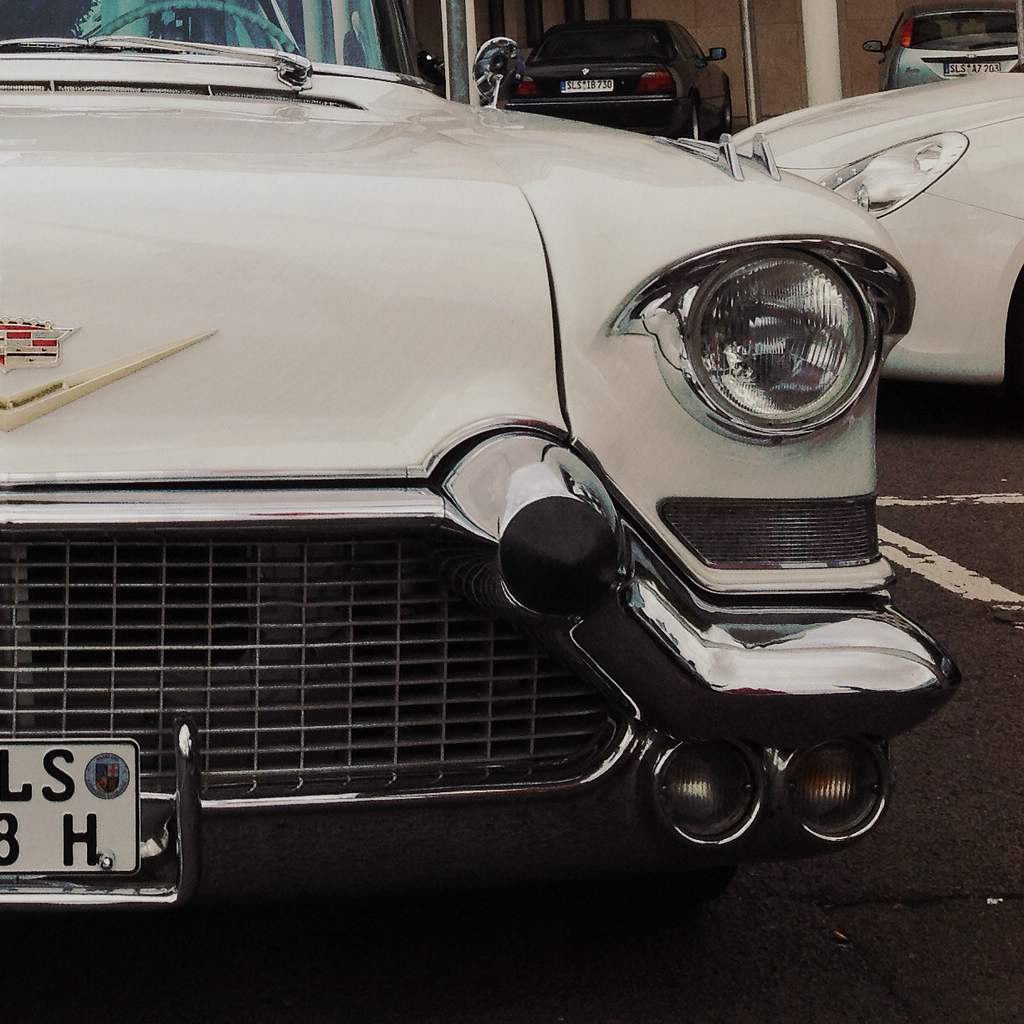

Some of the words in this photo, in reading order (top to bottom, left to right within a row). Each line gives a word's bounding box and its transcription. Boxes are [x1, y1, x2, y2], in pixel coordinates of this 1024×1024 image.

[950, 64, 966, 73] SLS
[567, 80, 583, 90] SLS
[63, 813, 97, 866] H
